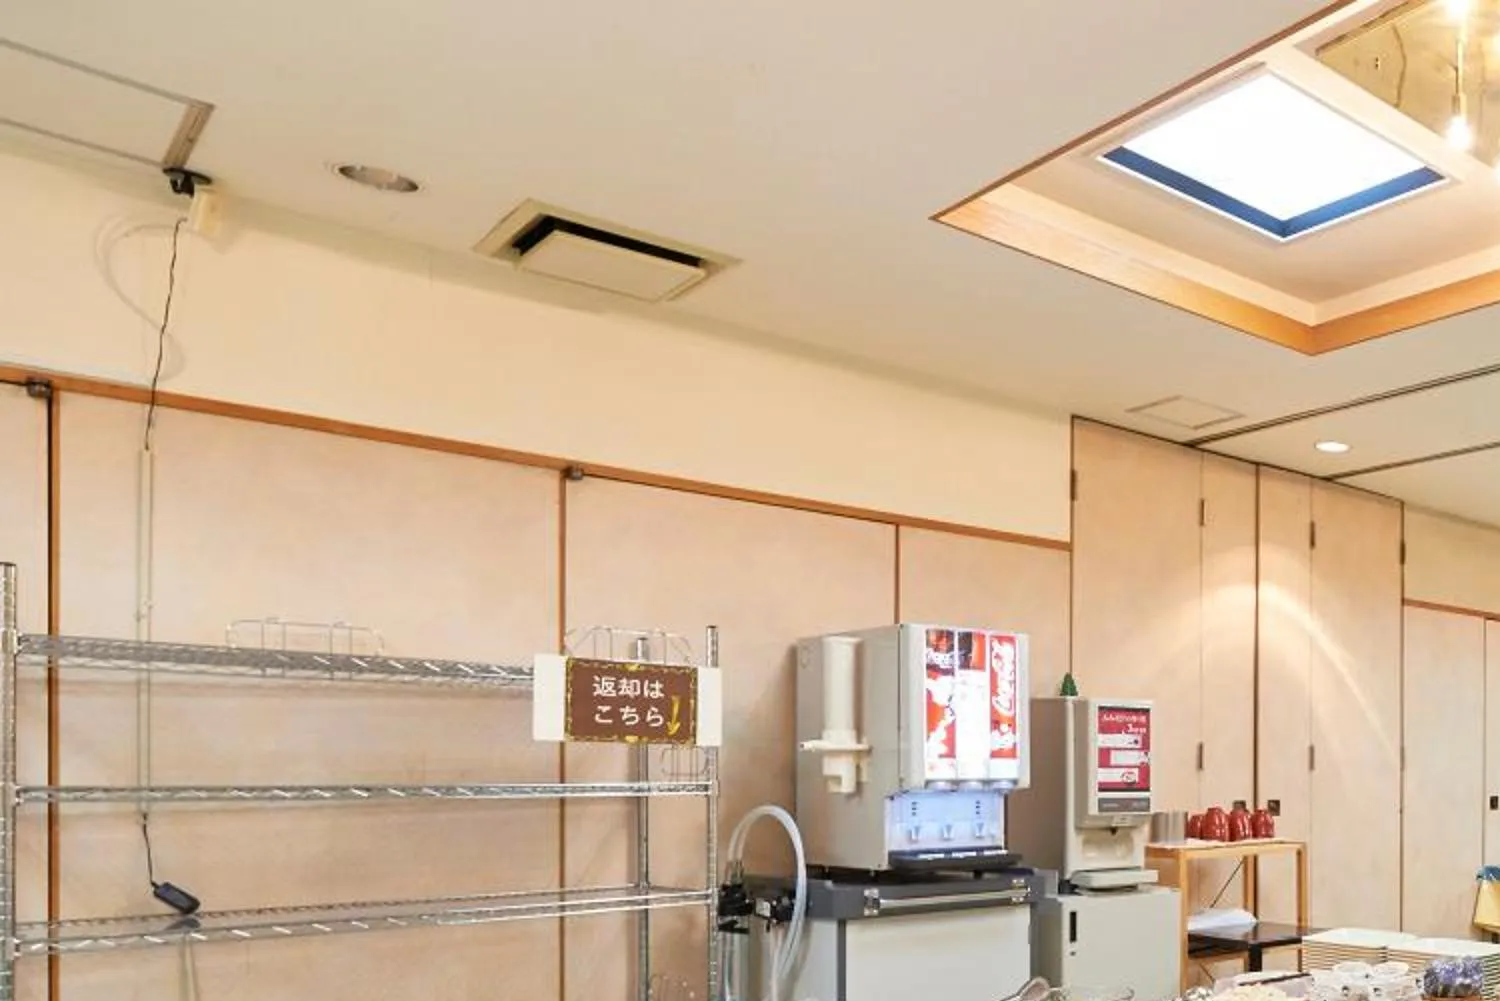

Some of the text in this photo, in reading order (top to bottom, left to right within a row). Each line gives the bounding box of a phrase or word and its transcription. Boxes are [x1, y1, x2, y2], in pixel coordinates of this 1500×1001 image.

[592, 675, 665, 699] 返却は
[595, 705, 664, 727] こちら
